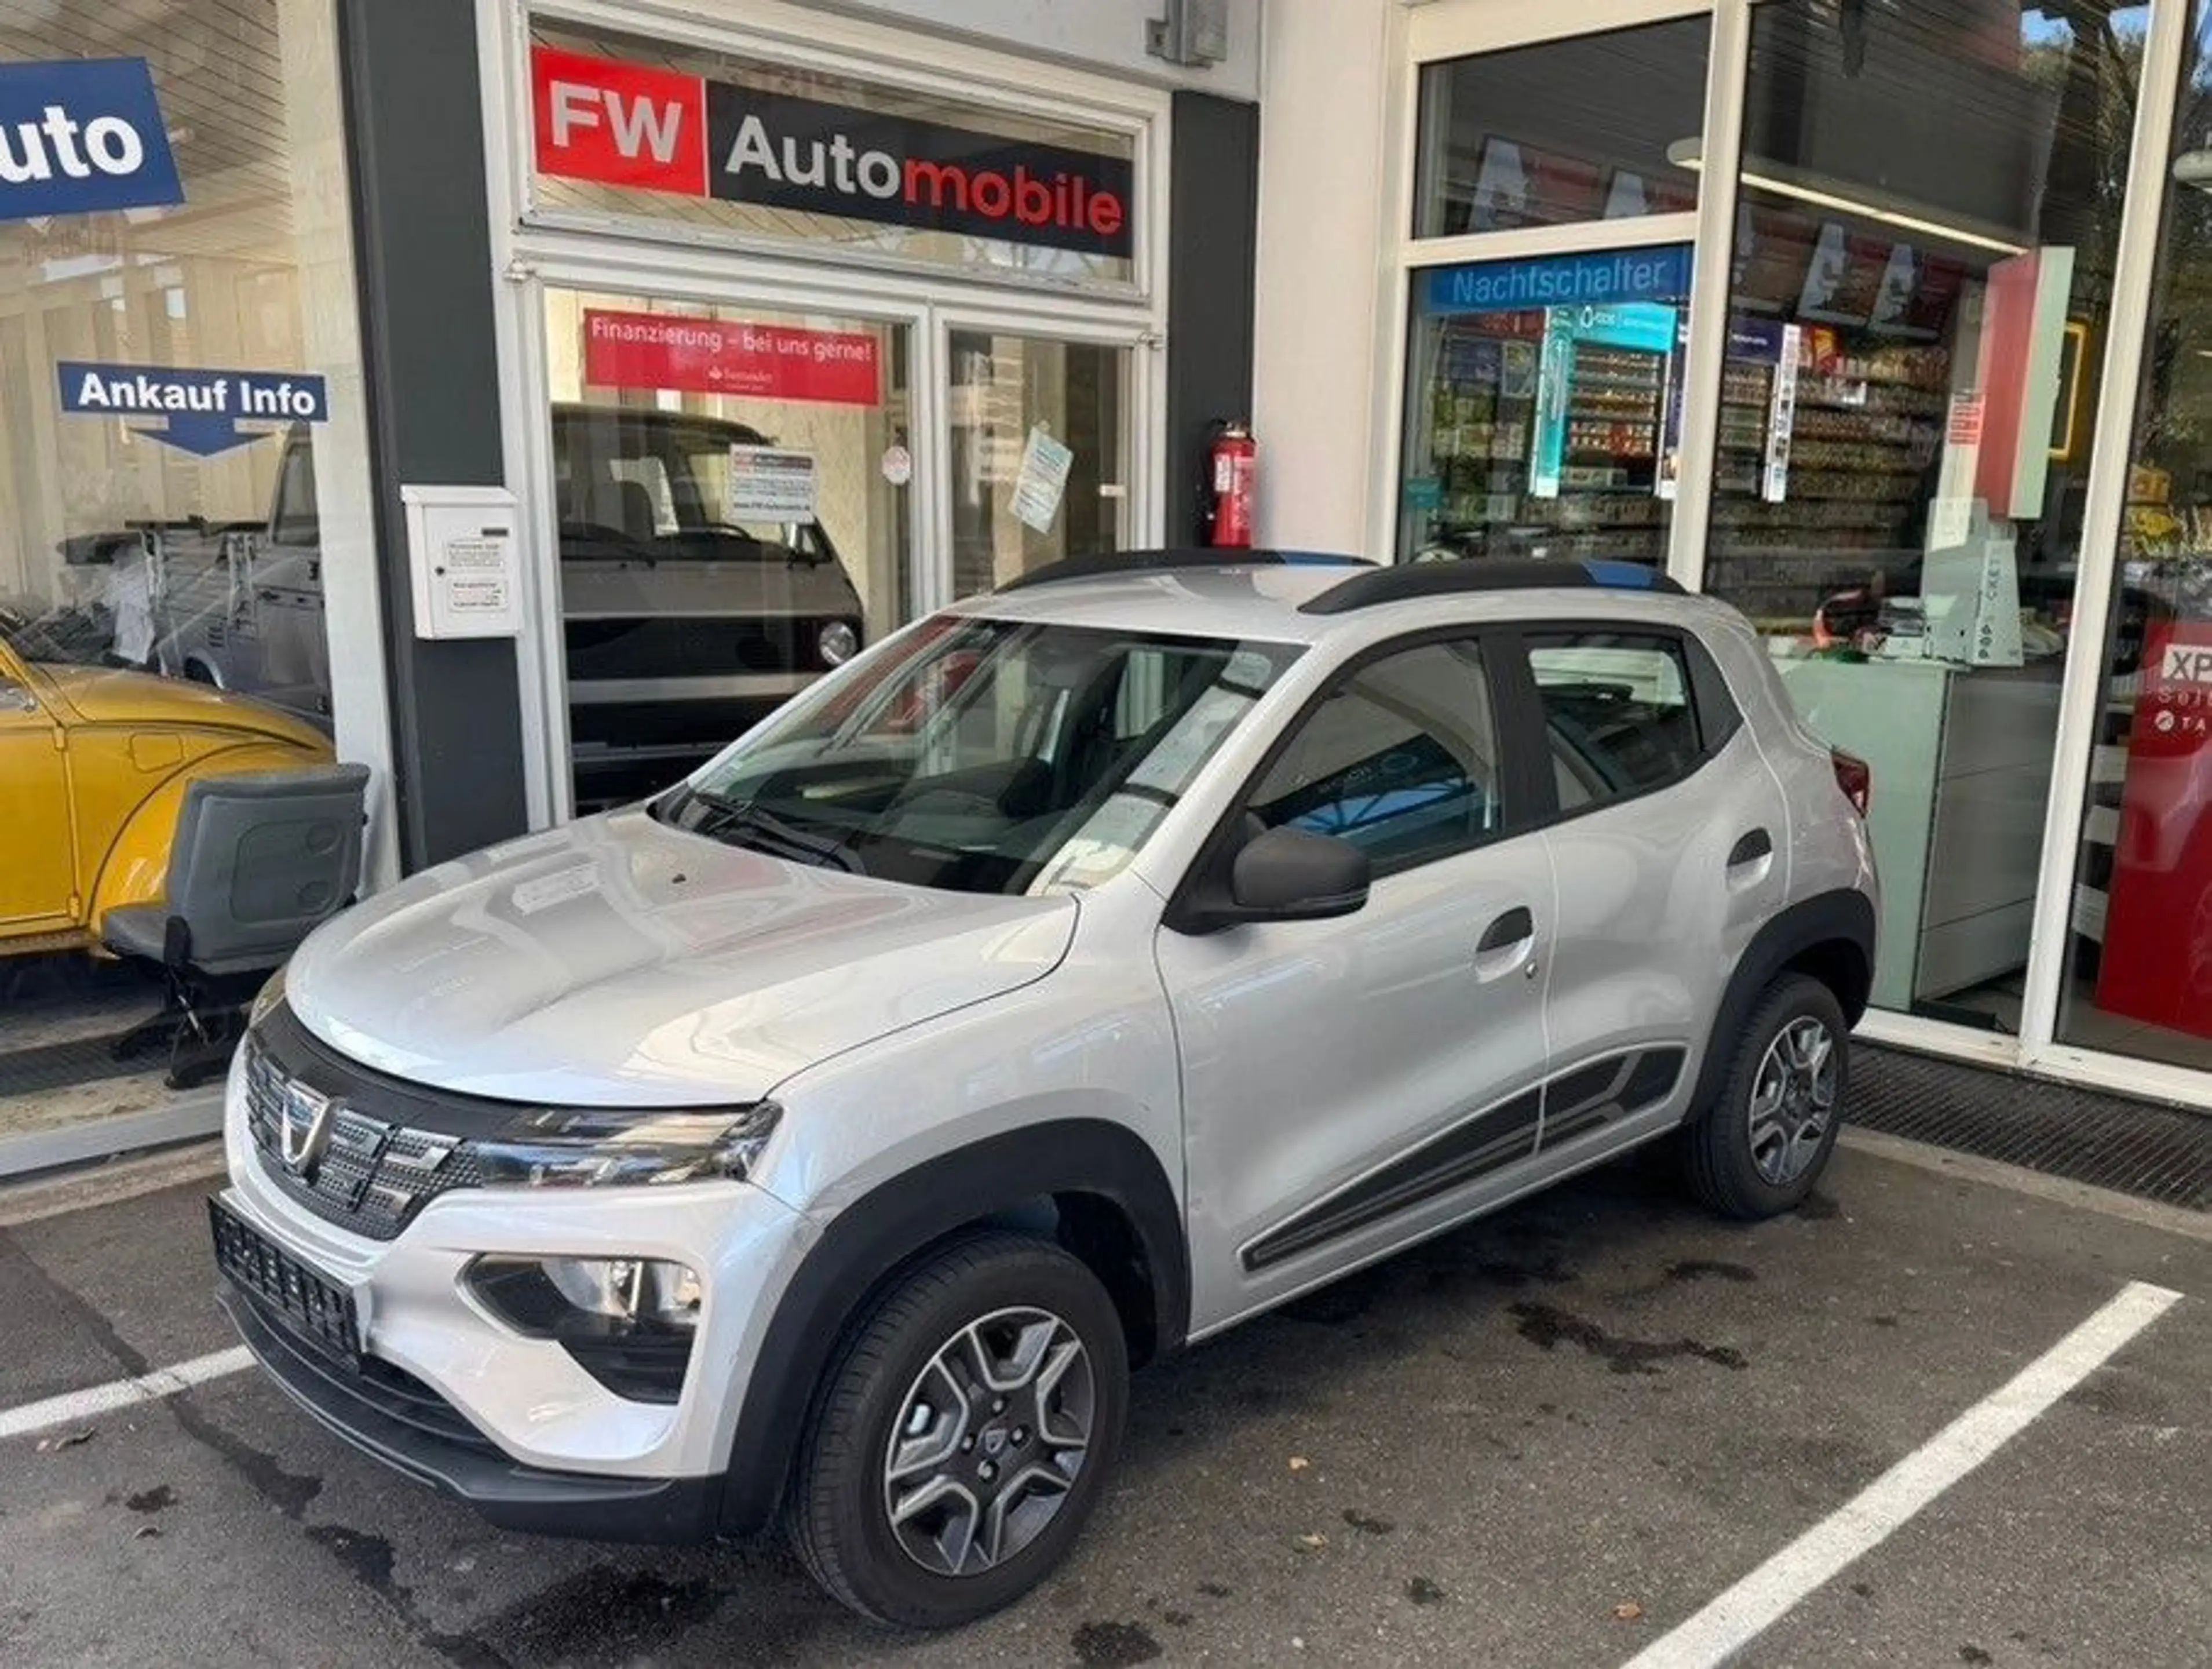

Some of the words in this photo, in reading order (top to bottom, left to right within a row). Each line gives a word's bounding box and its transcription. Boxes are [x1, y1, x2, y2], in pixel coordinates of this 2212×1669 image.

[0, 105, 143, 183] uto
[550, 80, 682, 162] FW
[725, 115, 1123, 234] Automobile
[1454, 257, 1667, 303] Nachtschalter
[592, 316, 723, 354] Finanzierung
[743, 330, 772, 352] bei
[778, 338, 809, 356] uns
[813, 342, 872, 363] gerne!
[79, 373, 227, 411] Ankauf
[241, 381, 316, 416] Info
